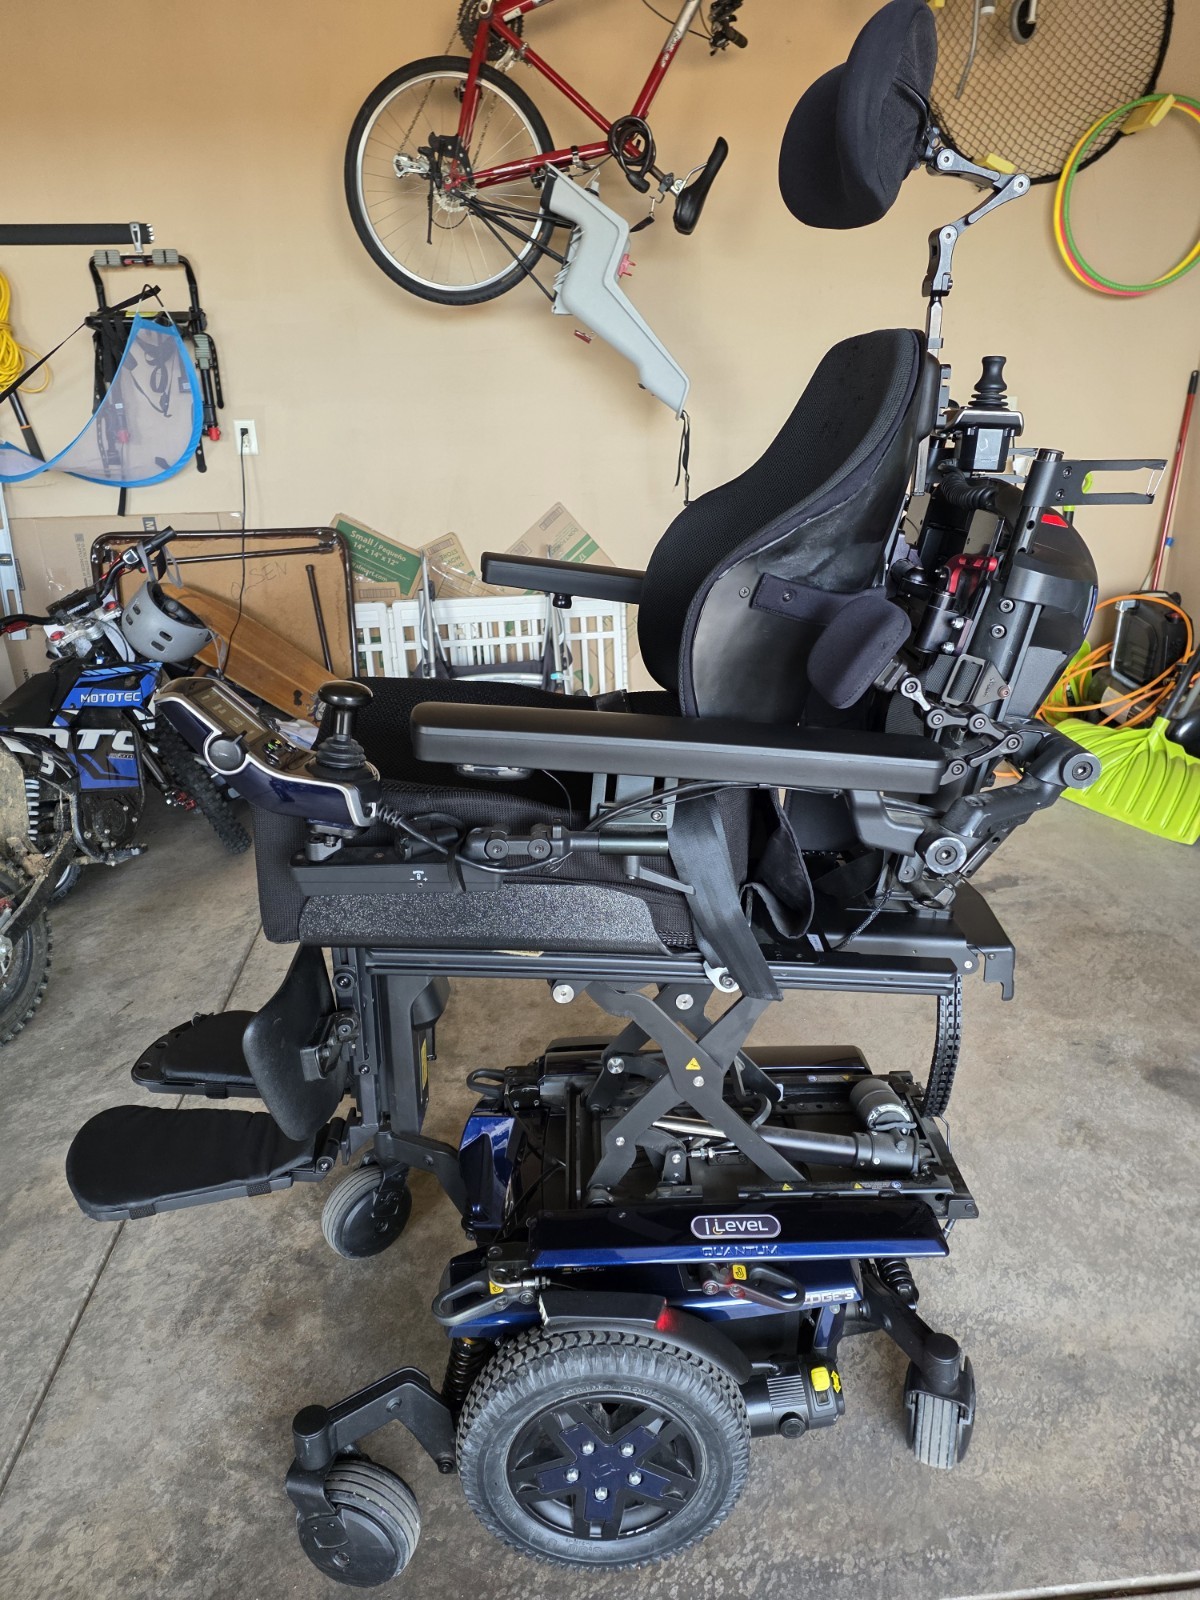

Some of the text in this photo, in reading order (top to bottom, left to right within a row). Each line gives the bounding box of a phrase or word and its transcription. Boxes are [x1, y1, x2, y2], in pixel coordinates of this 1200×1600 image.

[350, 530, 374, 546] Small
[378, 545, 407, 562] Pequeño
[353, 541, 366, 550] 14"
[370, 549, 383, 558] 14"
[81, 692, 141, 703] MOTOTEC
[702, 1245, 778, 1257] QUANTUM
